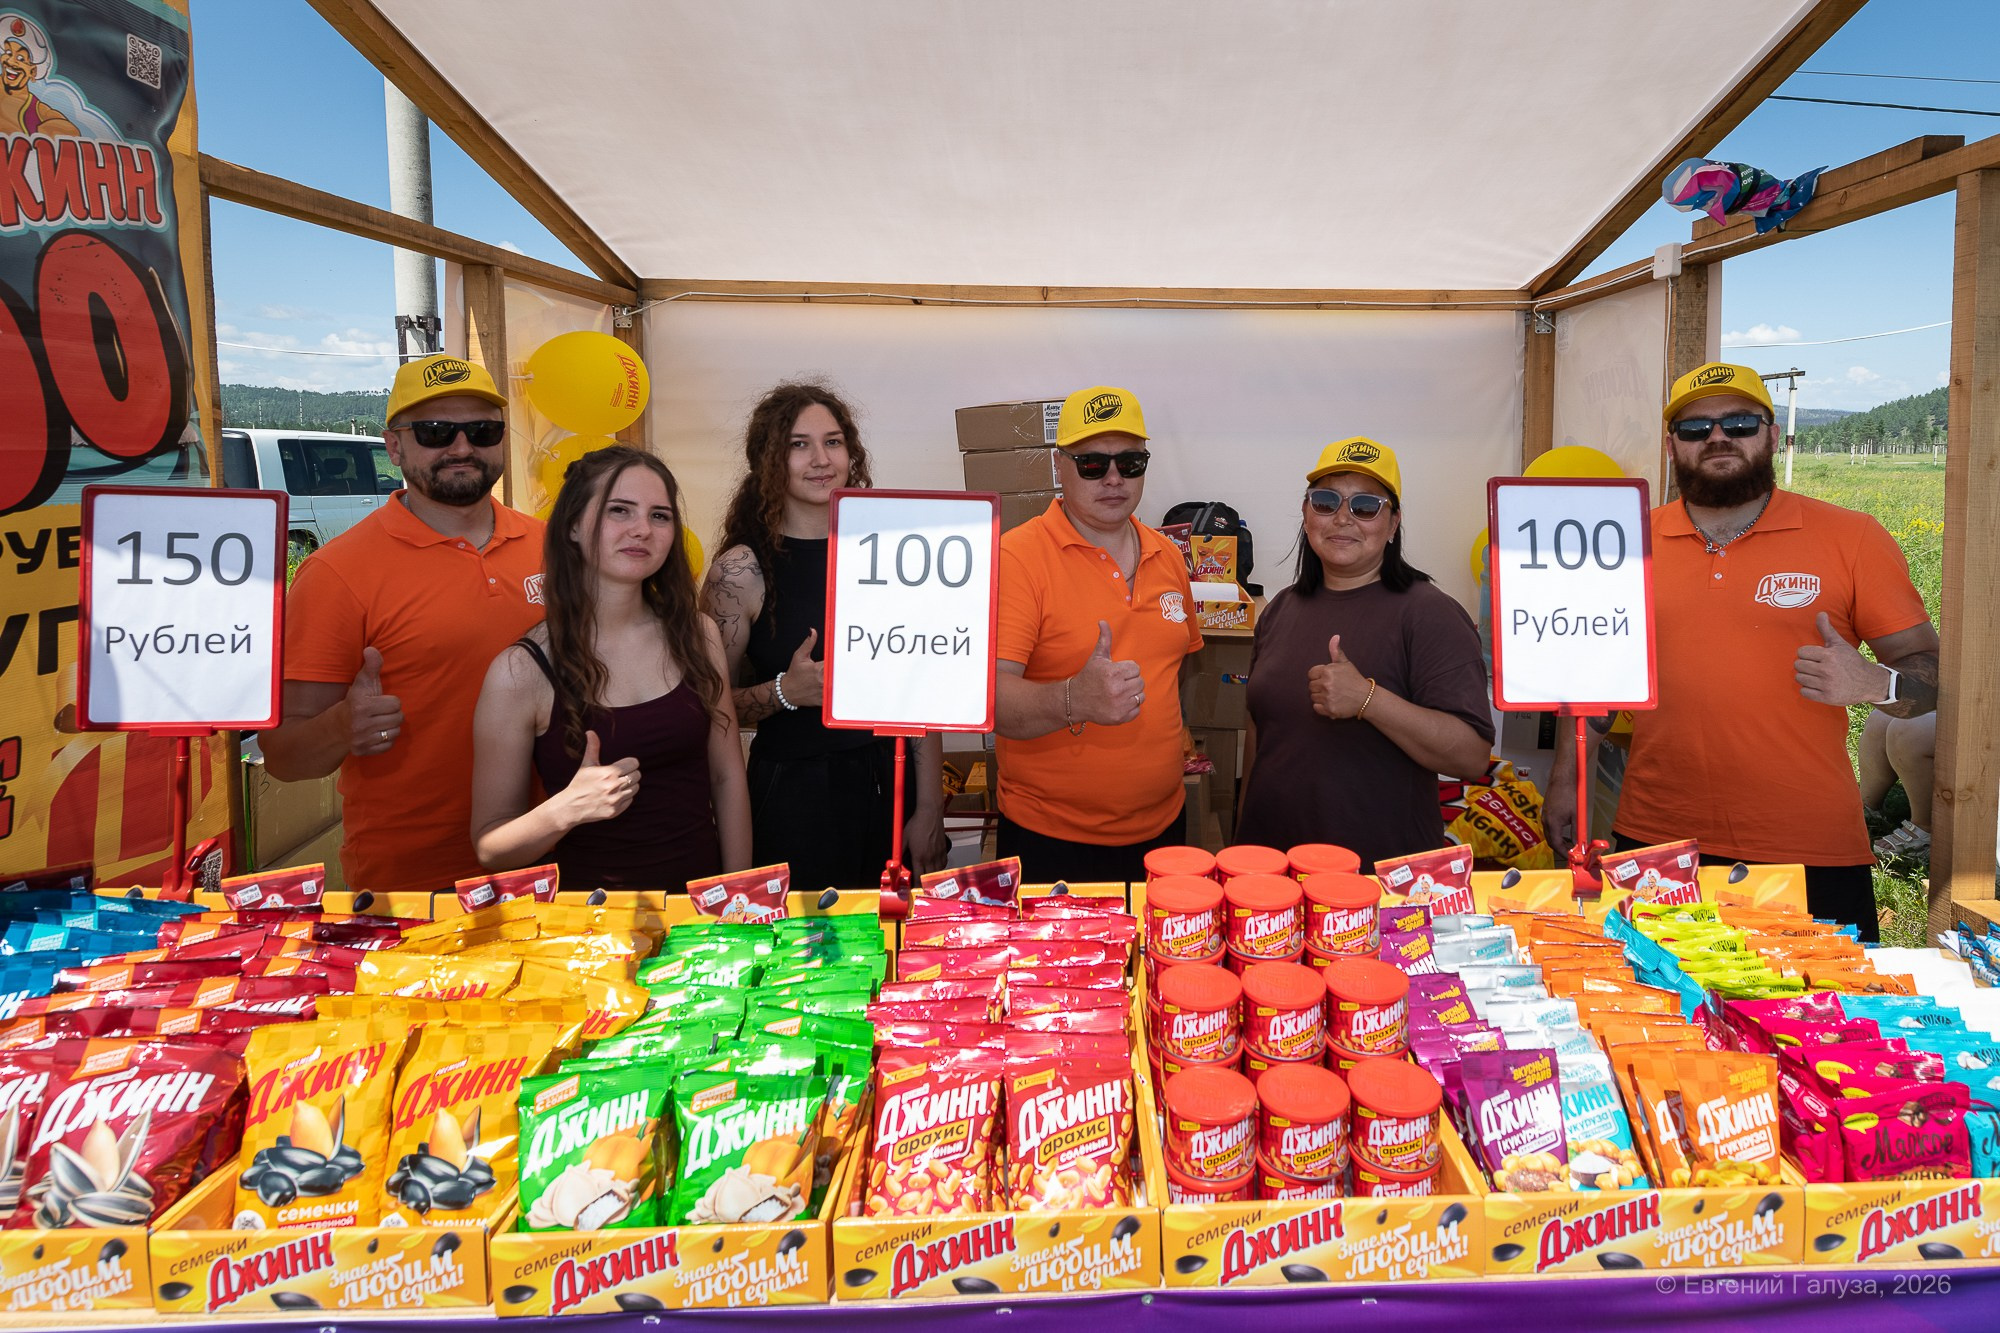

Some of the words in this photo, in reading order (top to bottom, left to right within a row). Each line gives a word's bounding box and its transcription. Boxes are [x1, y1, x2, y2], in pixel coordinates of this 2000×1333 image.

[117, 531, 254, 586] 150
[858, 533, 973, 588] 100
[1518, 518, 1626, 571] 100
[106, 624, 252, 661] Рублей
[848, 623, 970, 659] Рублей
[1513, 607, 1630, 641] Рублей
[1173, 932, 1205, 946] арахис
[1257, 930, 1289, 945] арахис
[1335, 926, 1367, 941] арахис
[1184, 1032, 1219, 1047] арахис
[1282, 1028, 1315, 1047] арахис
[1366, 1023, 1399, 1042] арахис
[897, 1123, 965, 1155] арахис
[1043, 1119, 1107, 1156] арахис
[1206, 1145, 1242, 1166] арахис
[1296, 1144, 1333, 1163] арахис
[1382, 1140, 1421, 1156] арахис
[277, 1200, 359, 1223] семечки
[1187, 1209, 1263, 1250] семечки
[1503, 1199, 1580, 1238] семечки
[1826, 1190, 1902, 1229] семечки
[169, 1237, 248, 1277] семечки
[855, 1223, 933, 1263] семечки
[1345, 1220, 1462, 1281] любим
[1405, 1235, 1469, 1279] едим!
[1661, 1209, 1778, 1267] любим
[1721, 1223, 1785, 1265] едим!
[338, 1249, 455, 1308] любим
[514, 1239, 593, 1280] семечки
[683, 1247, 801, 1307] любим
[1018, 1232, 1135, 1292] любим
[1078, 1246, 1142, 1291] едим!
[7, 1255, 123, 1311] любим
[69, 1269, 134, 1311] едим!
[400, 1264, 465, 1307] едим!
[744, 1261, 810, 1305] едим!
